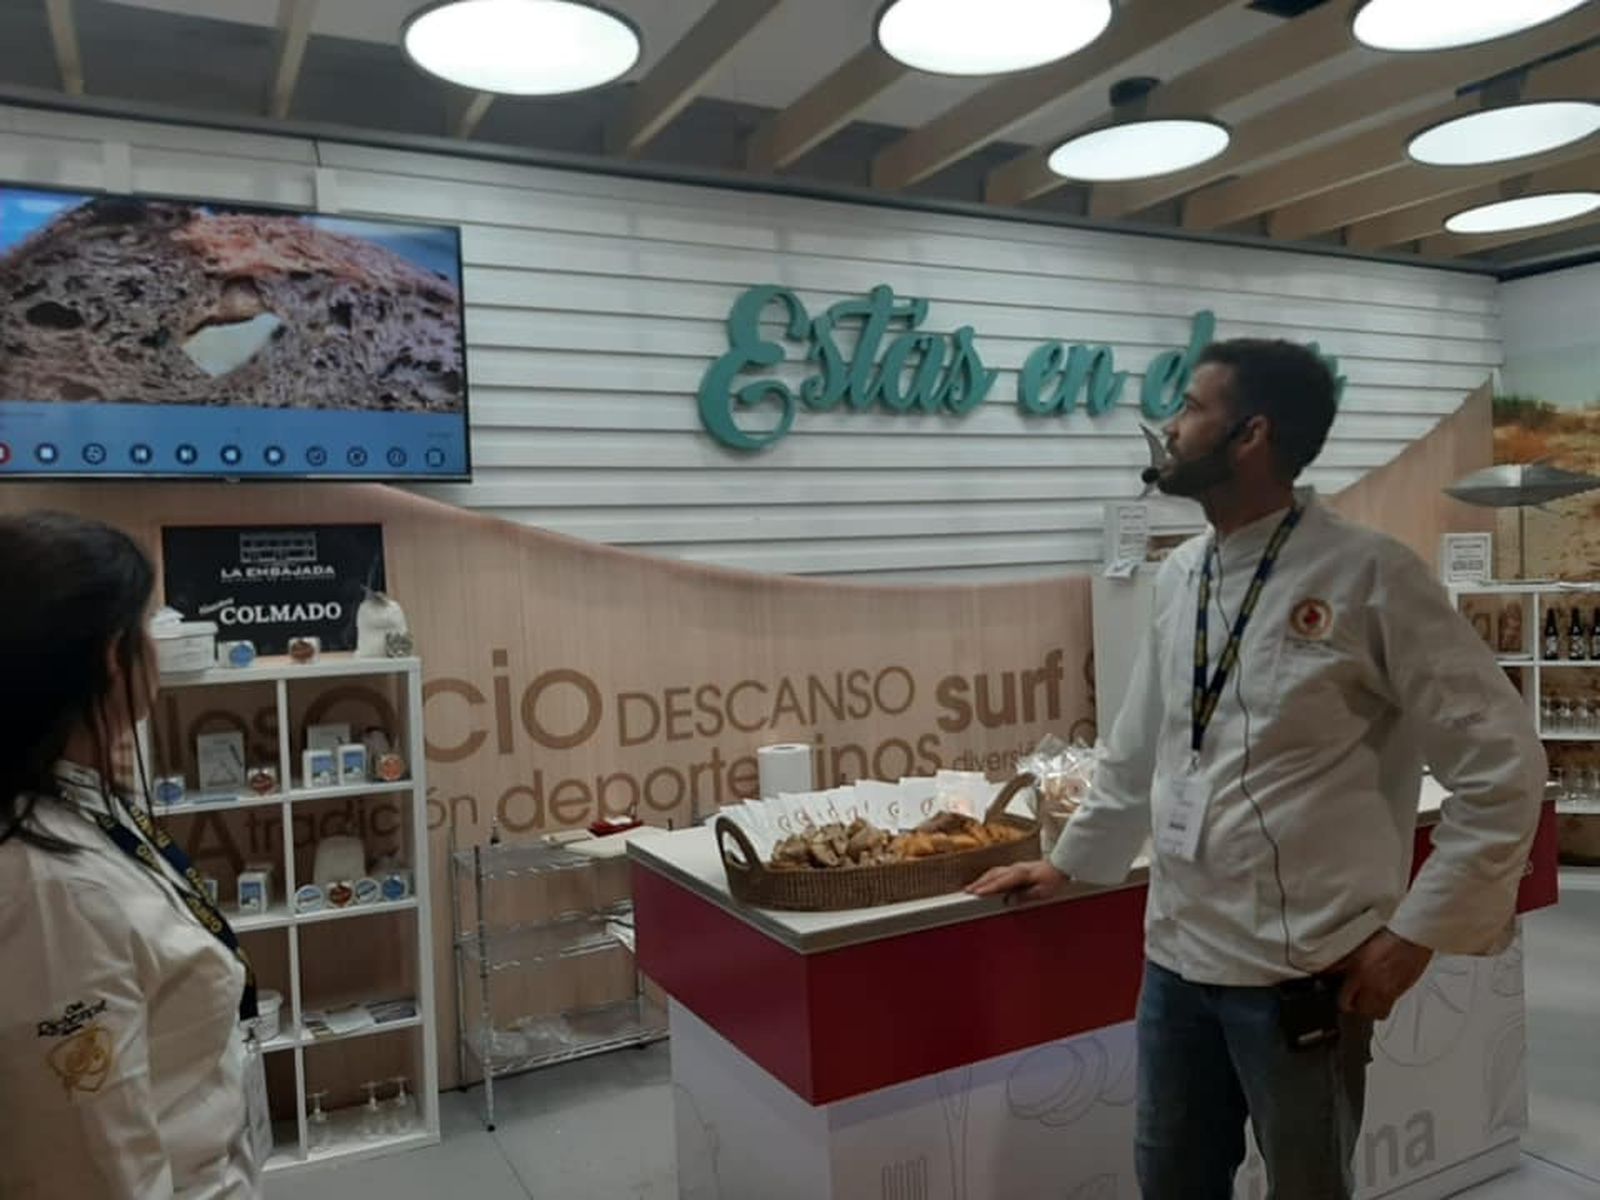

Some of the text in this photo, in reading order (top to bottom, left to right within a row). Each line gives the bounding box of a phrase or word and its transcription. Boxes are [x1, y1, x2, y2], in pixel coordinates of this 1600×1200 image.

[1016, 337, 1131, 418] en
[220, 563, 336, 579] LA EMBAJADA
[219, 601, 342, 625] COLMADO
[617, 666, 916, 747] DESCANSO
[936, 648, 1064, 733] surf
[815, 732, 942, 790] inos
[245, 786, 480, 855] tradicón
